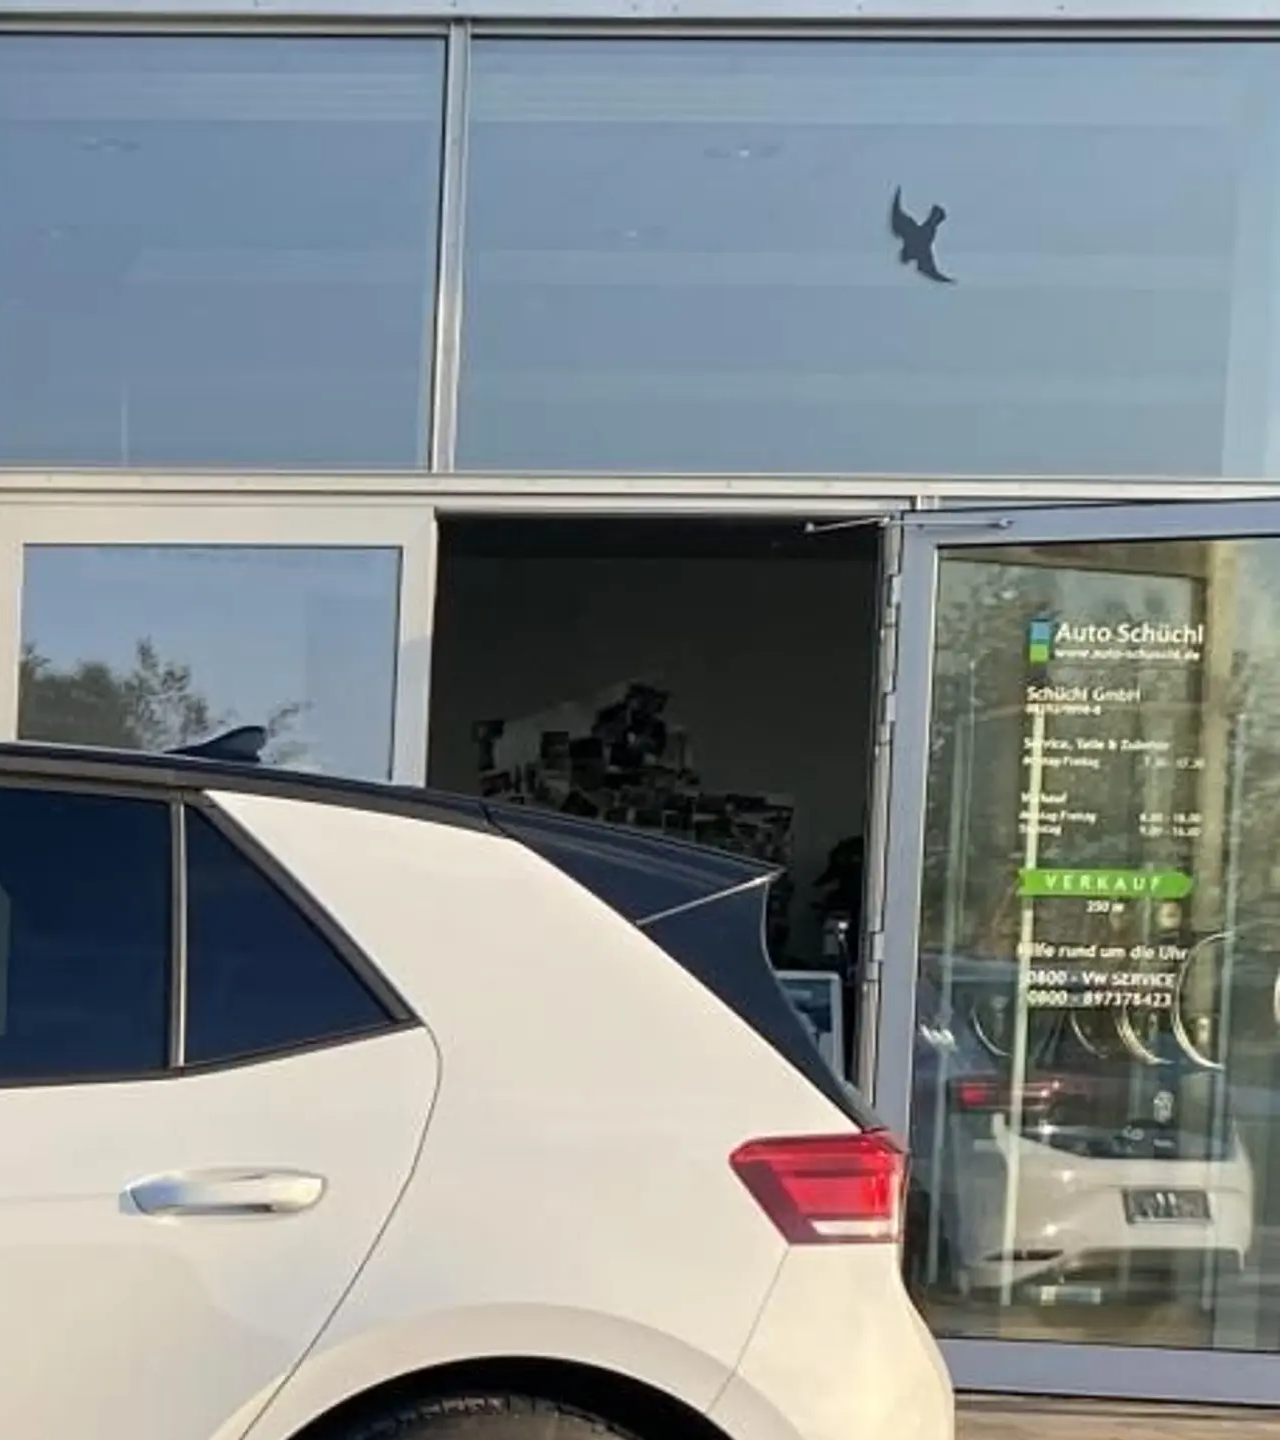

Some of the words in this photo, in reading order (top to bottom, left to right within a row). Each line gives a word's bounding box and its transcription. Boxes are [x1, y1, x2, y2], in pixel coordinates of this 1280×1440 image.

[1054, 621, 1112, 643] Auto
[1116, 621, 1204, 645] Schüchl
[1044, 874, 1163, 892] VERKAUF
[1057, 944, 1097, 958] rund
[1128, 945, 1155, 960] die
[1158, 945, 1188, 961] Uhr
